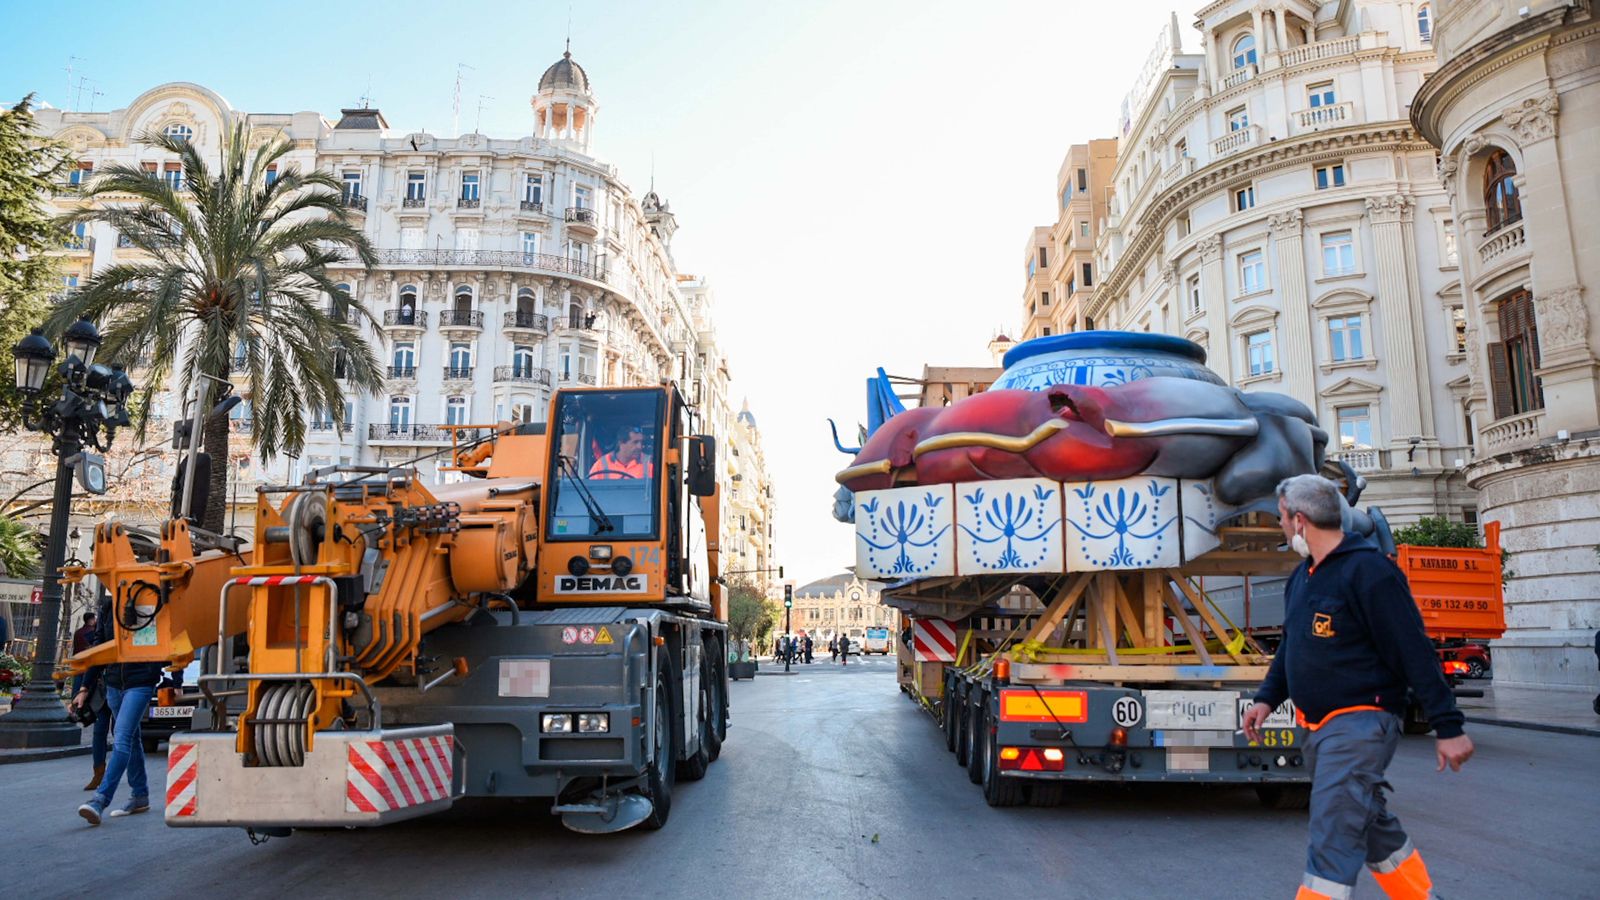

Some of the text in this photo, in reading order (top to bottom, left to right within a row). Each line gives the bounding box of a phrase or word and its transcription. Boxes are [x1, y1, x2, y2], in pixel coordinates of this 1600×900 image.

[630, 546, 660, 567] 174
[1420, 557, 1458, 569] NAVARRO
[560, 577, 641, 591] DEMAG
[34, 592, 40, 601] 2
[1431, 599, 1488, 610] 96 132 49 50
[1117, 701, 1137, 722] 60
[1172, 700, 1216, 722] rigar
